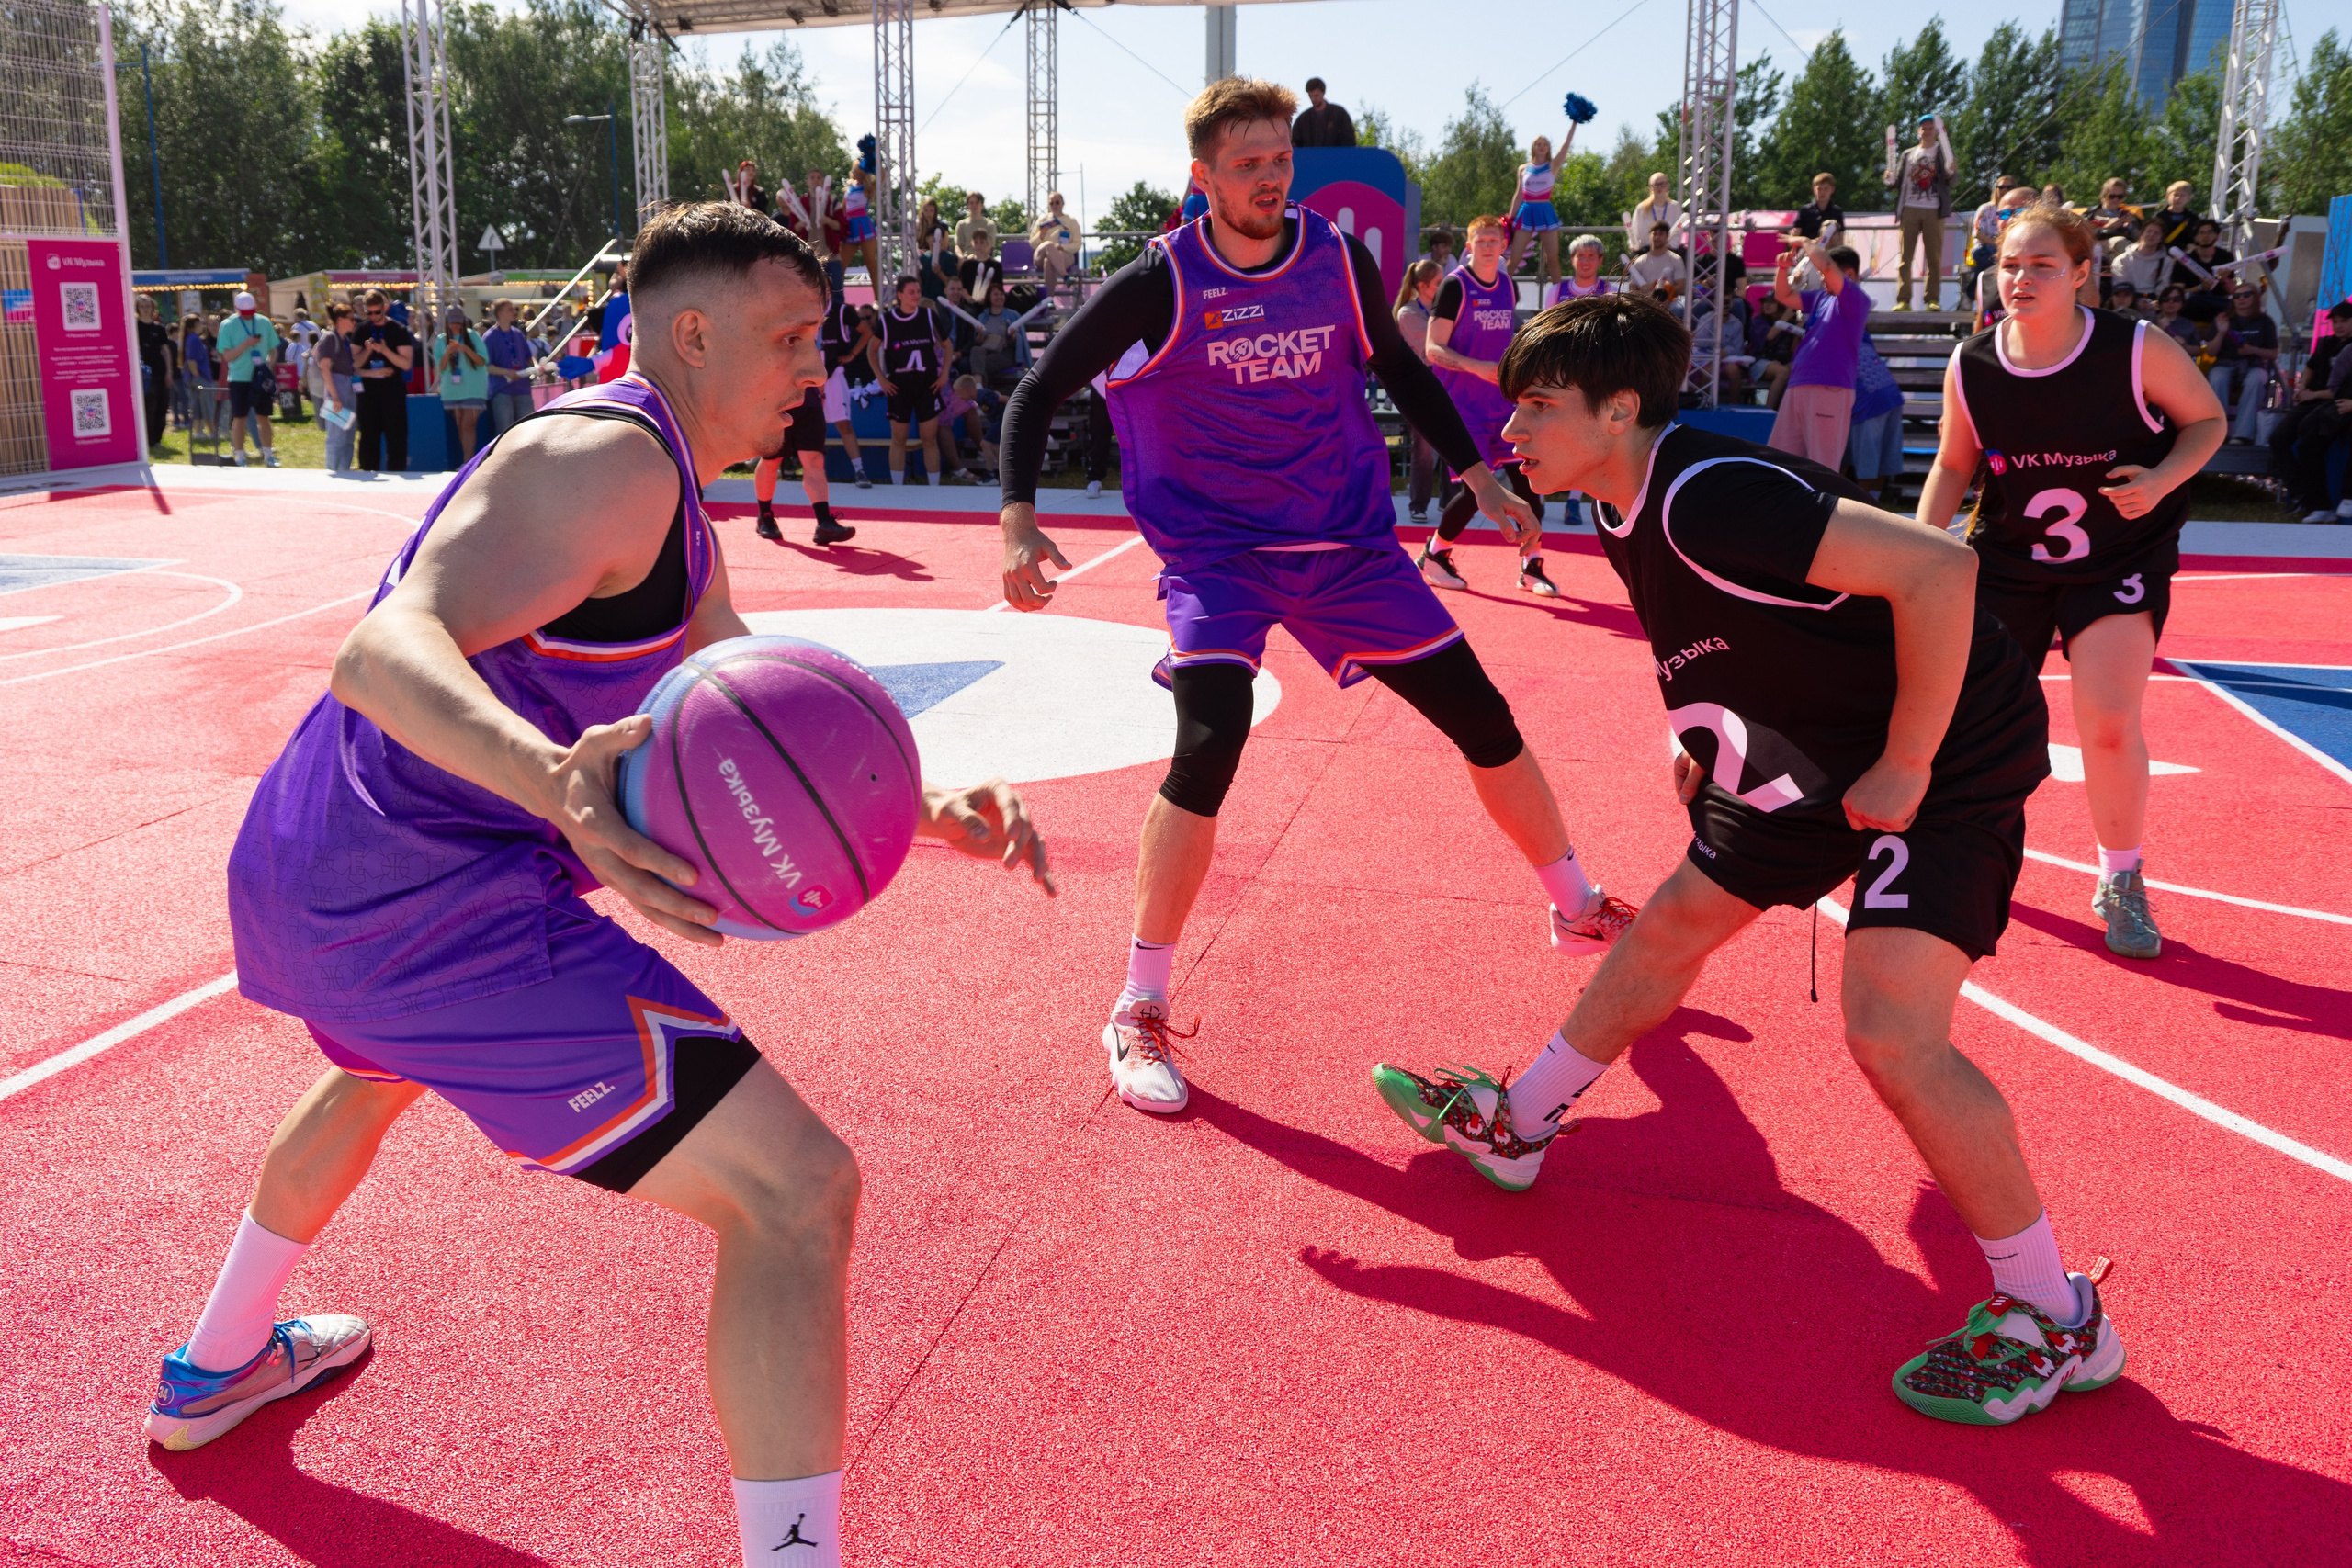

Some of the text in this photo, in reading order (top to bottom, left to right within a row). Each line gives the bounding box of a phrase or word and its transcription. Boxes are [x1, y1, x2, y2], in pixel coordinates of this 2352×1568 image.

[1203, 287, 1228, 299] FEELZ.
[1474, 310, 1512, 321] ROCKET
[1480, 319, 1510, 331] TEAM
[1207, 324, 1336, 366] ROCKET
[1227, 351, 1322, 385] TEAM
[2011, 450, 2117, 468] VK Музыка
[2023, 488, 2090, 565] 3
[2113, 573, 2145, 604] 3
[1654, 637, 1731, 682] узыка
[1666, 702, 1804, 813] 2
[718, 758, 803, 889] VK Музыка
[1863, 834, 1909, 909] 2
[567, 1081, 616, 1113] FEELZ.
[158, 1385, 168, 1401] 34
